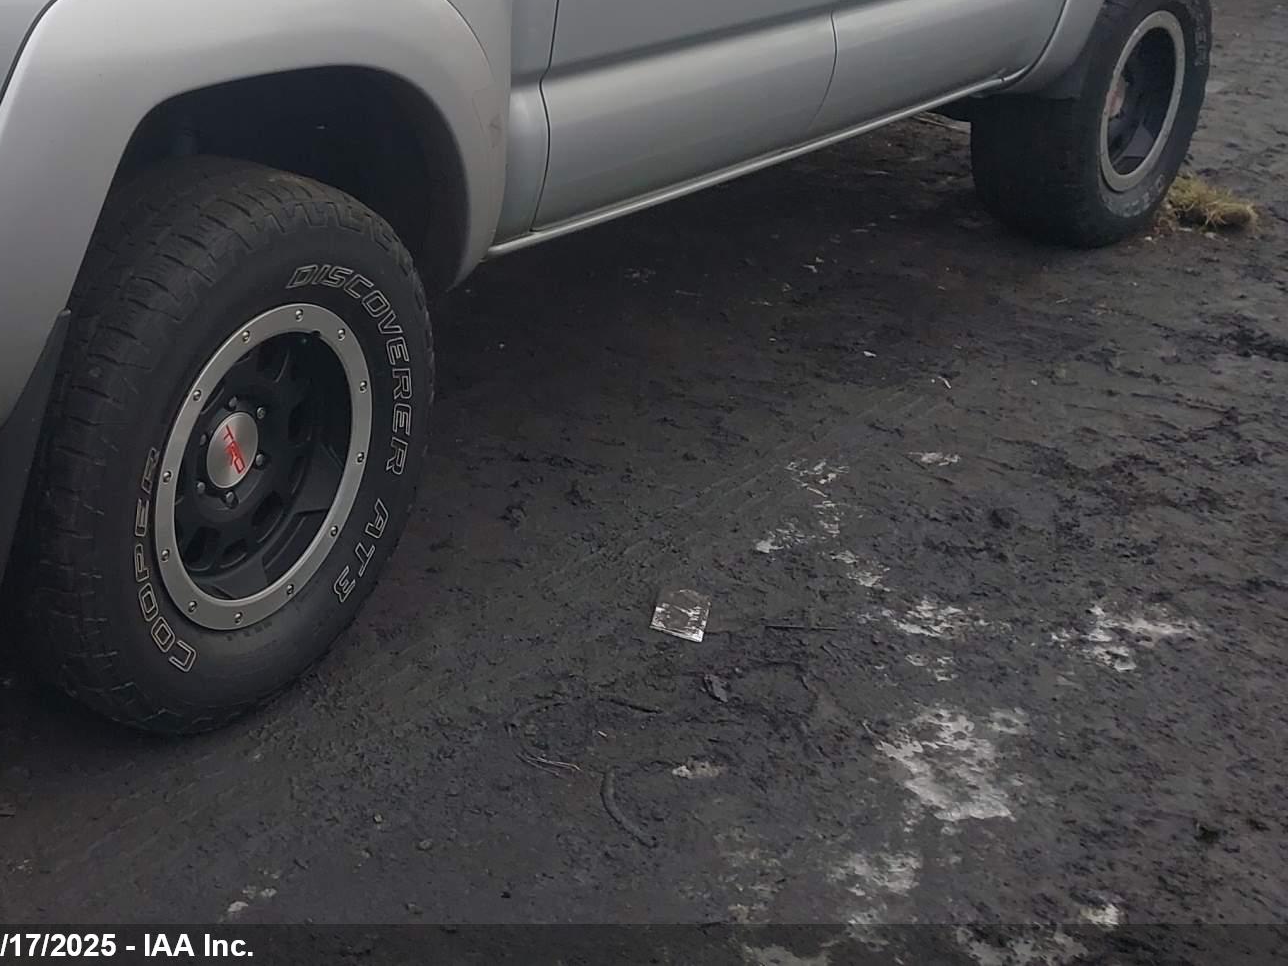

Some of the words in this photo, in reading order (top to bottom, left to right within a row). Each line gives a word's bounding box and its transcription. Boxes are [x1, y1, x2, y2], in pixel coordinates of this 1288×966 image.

[286, 264, 413, 476] DISCOVERER
[223, 425, 246, 474] TRD
[133, 446, 198, 673] COOPER
[332, 498, 392, 603] AT3
